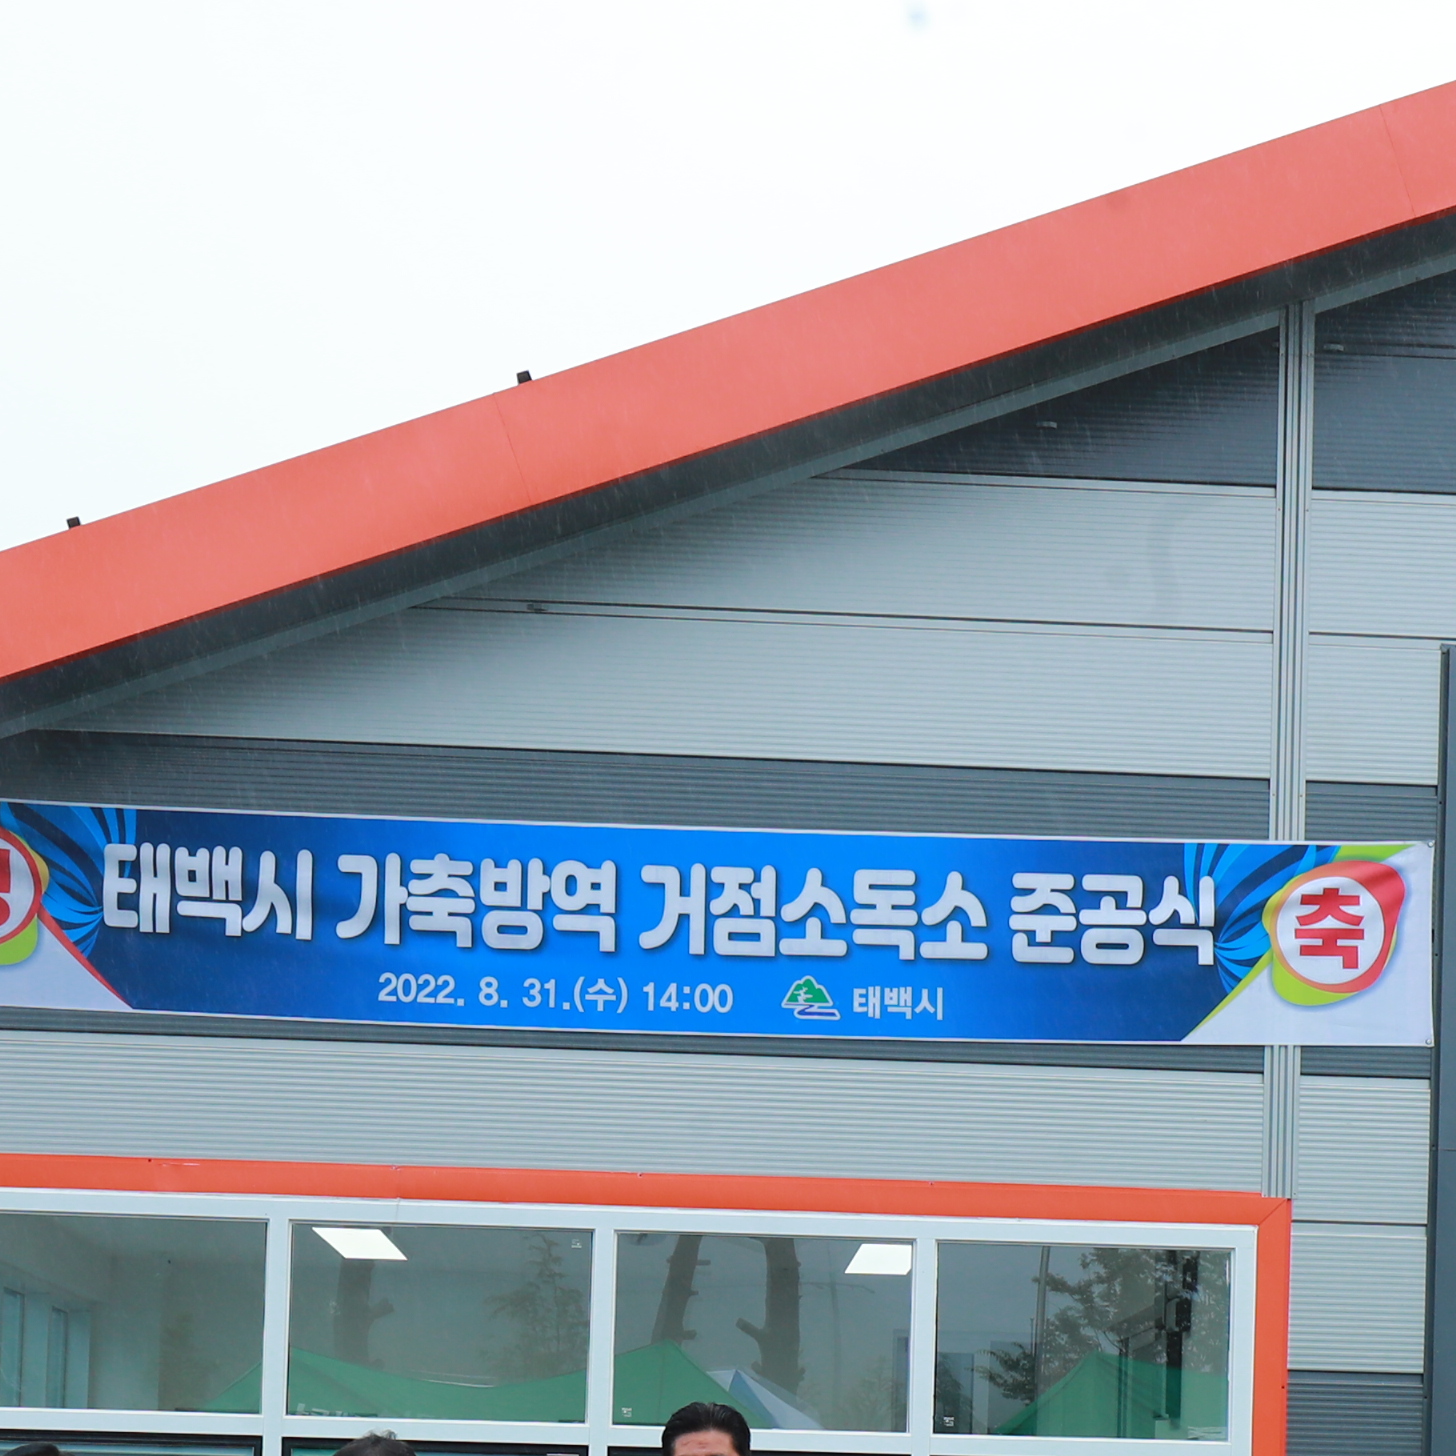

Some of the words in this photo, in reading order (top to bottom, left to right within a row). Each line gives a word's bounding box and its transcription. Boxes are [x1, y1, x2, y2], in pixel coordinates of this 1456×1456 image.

[103, 842, 313, 940] 태백시
[336, 853, 616, 952] 가축방역
[639, 863, 988, 960] 거점소독소
[1009, 872, 1215, 965] 준공식
[1292, 886, 1364, 971] 축
[378, 972, 464, 1006] 2022.
[479, 977, 508, 1007] 8.
[523, 977, 628, 1013] 31.(수)
[643, 982, 733, 1013] 14:00
[853, 986, 943, 1020] 태백시
